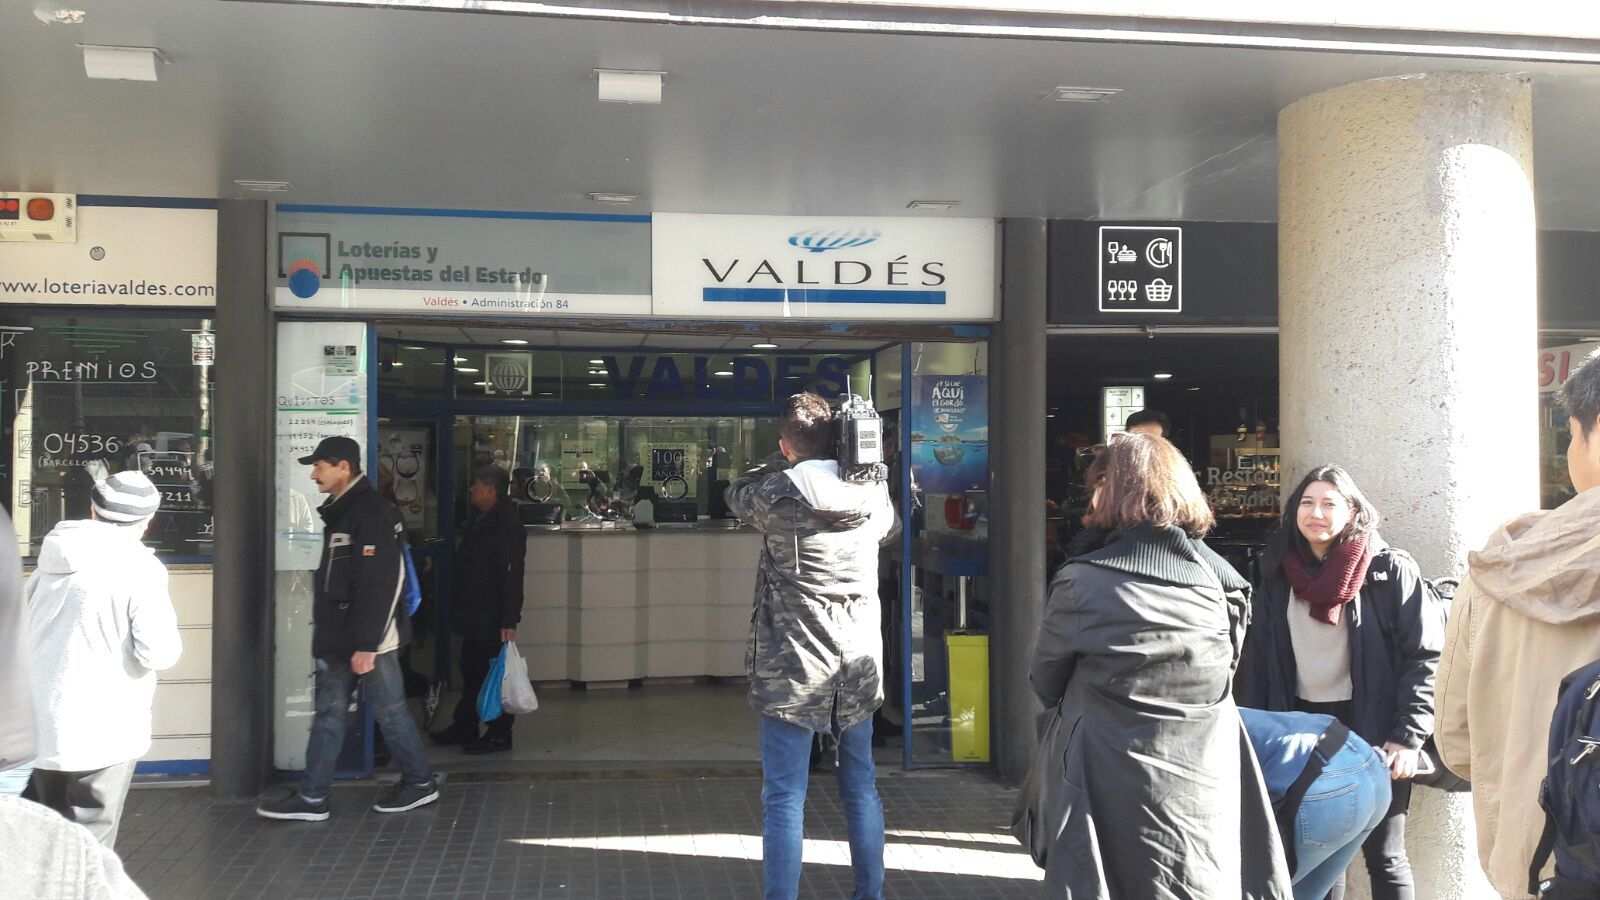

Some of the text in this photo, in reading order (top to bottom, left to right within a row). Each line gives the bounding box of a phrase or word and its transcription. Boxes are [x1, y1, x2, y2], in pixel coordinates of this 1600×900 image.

[338, 240, 438, 263] Loterías y
[338, 264, 543, 286] Apuestas del Estado
[702, 255, 946, 287] VALDÉS
[0, 278, 214, 297] ww.loteriavaldes.com
[471, 297, 553, 309] Administración
[556, 299, 568, 309] 84
[44, 433, 119, 454] 04536
